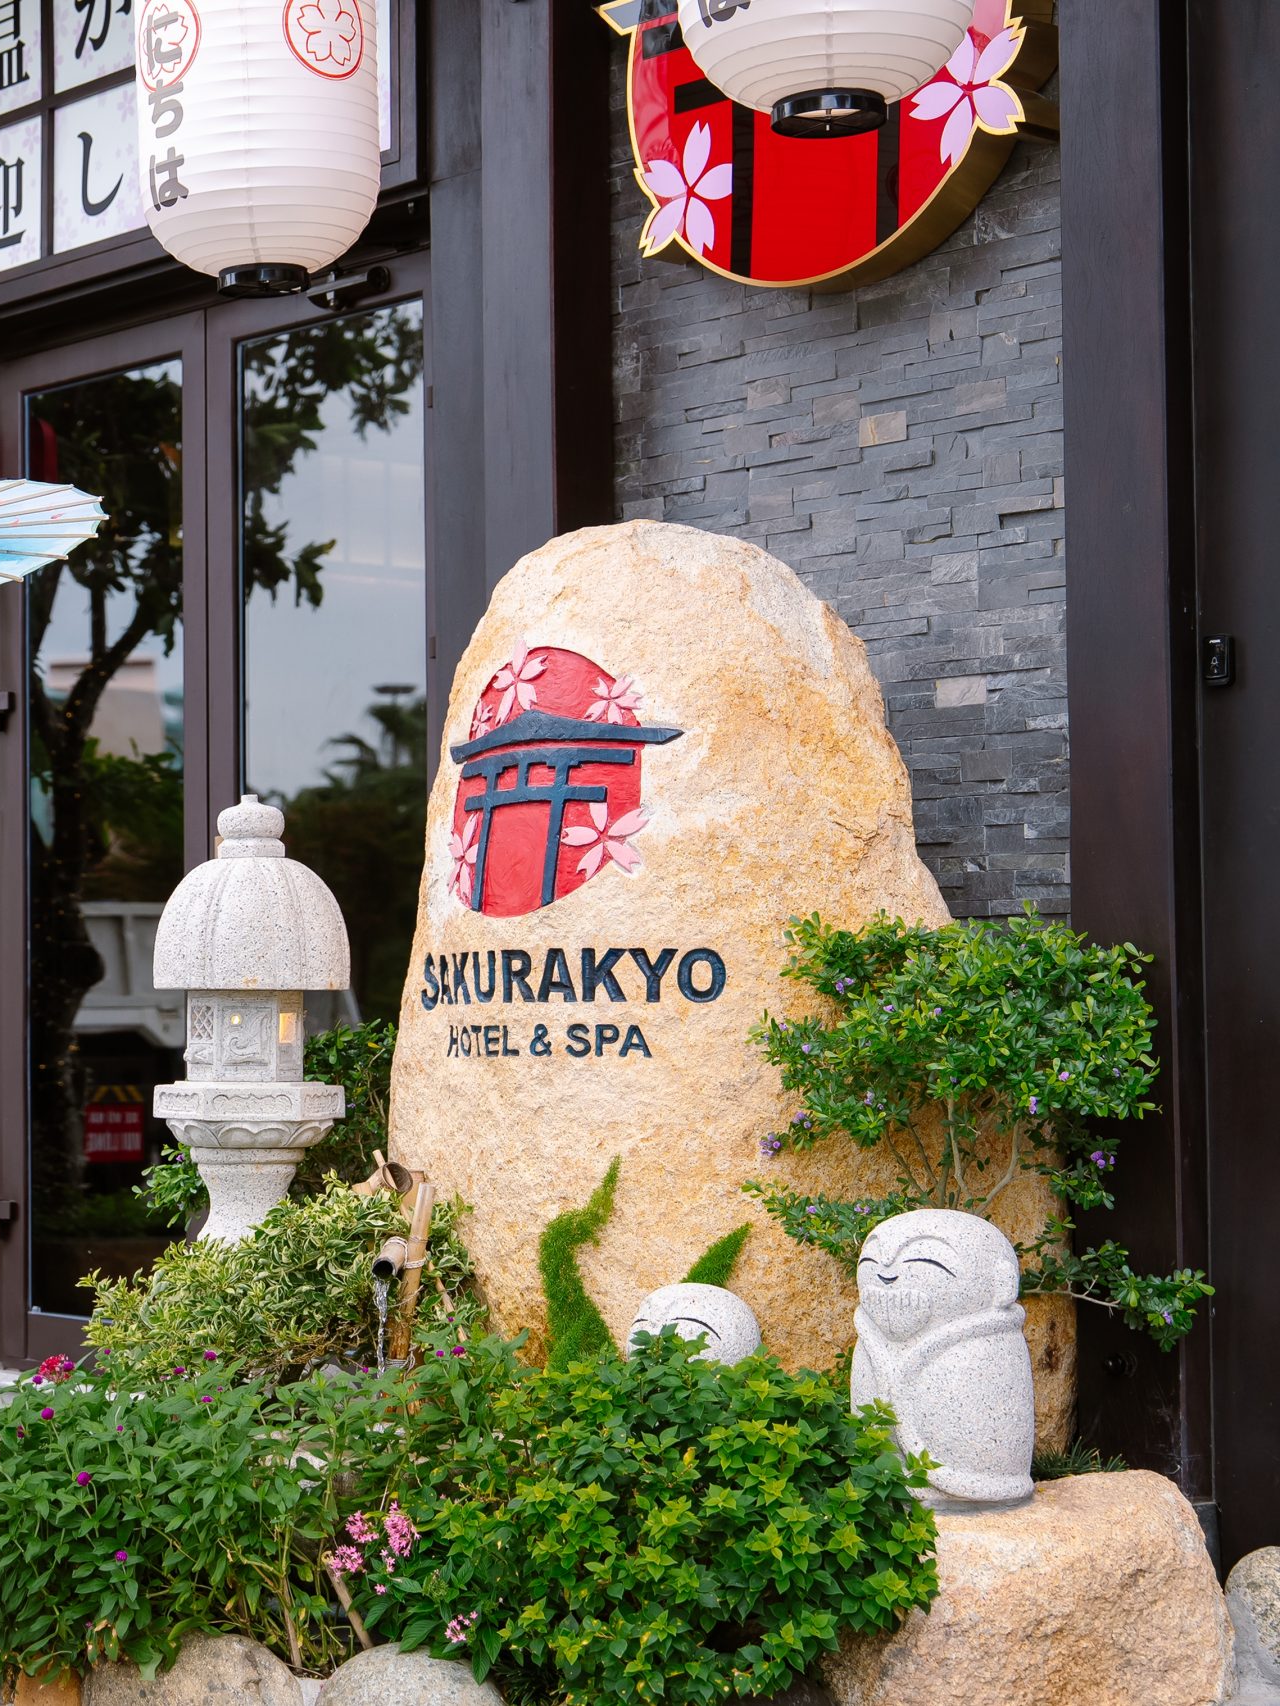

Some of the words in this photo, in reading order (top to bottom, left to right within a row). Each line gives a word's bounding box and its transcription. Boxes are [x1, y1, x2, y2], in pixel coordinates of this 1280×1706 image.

[421, 947, 727, 1011] SAKURAKYO
[447, 1024, 520, 1058] HOTEL
[529, 1023, 552, 1057] &
[565, 1023, 652, 1058] SPA
